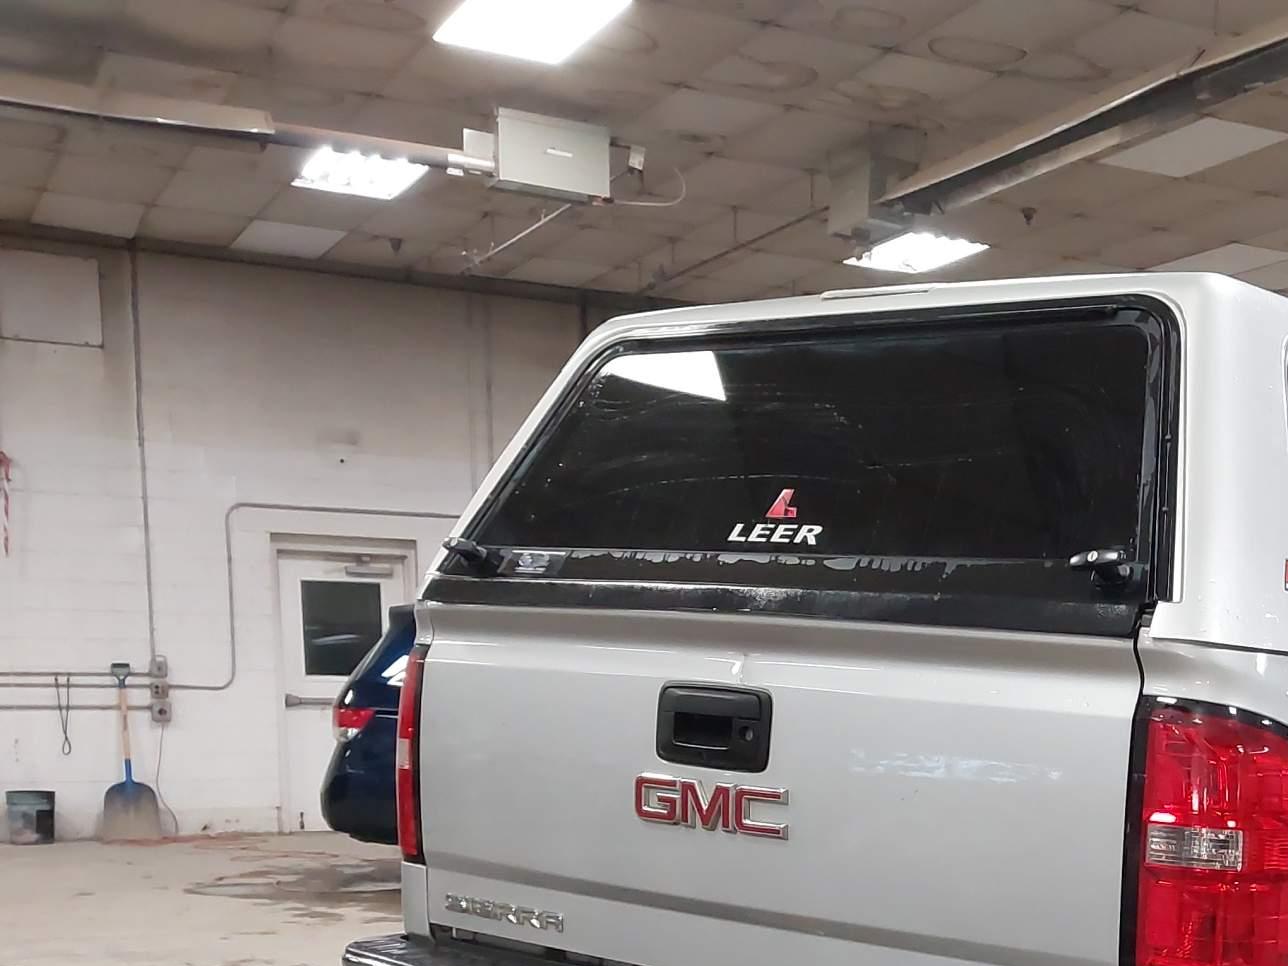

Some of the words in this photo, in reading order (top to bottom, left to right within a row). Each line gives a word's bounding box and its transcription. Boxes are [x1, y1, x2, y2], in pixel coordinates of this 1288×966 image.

[727, 523, 823, 545] LEER
[635, 772, 789, 841] GMC
[445, 892, 564, 934] SIERRA
